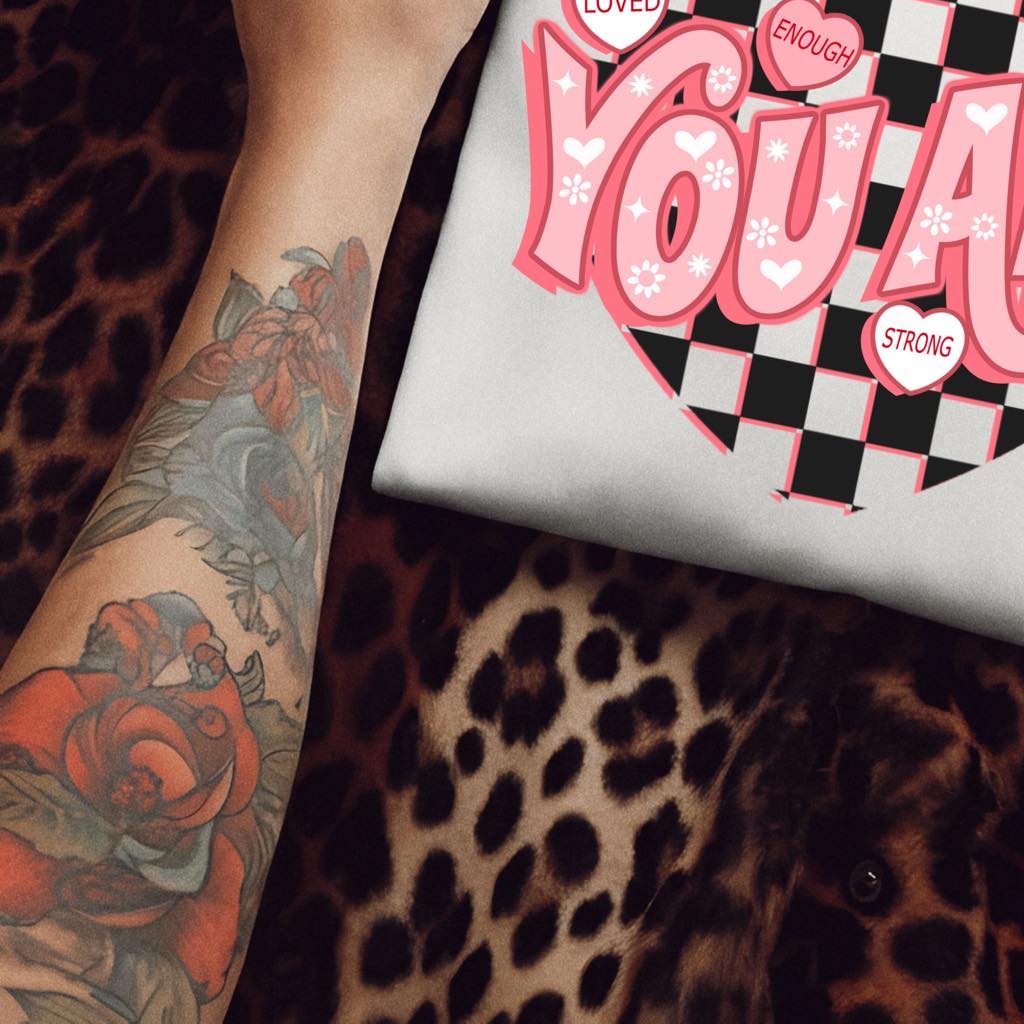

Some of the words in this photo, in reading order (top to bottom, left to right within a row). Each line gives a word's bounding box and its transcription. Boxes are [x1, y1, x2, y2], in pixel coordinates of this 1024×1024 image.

[772, 17, 856, 69] ENOUGH
[513, 18, 890, 324] YOU
[881, 326, 955, 358] STRONG
